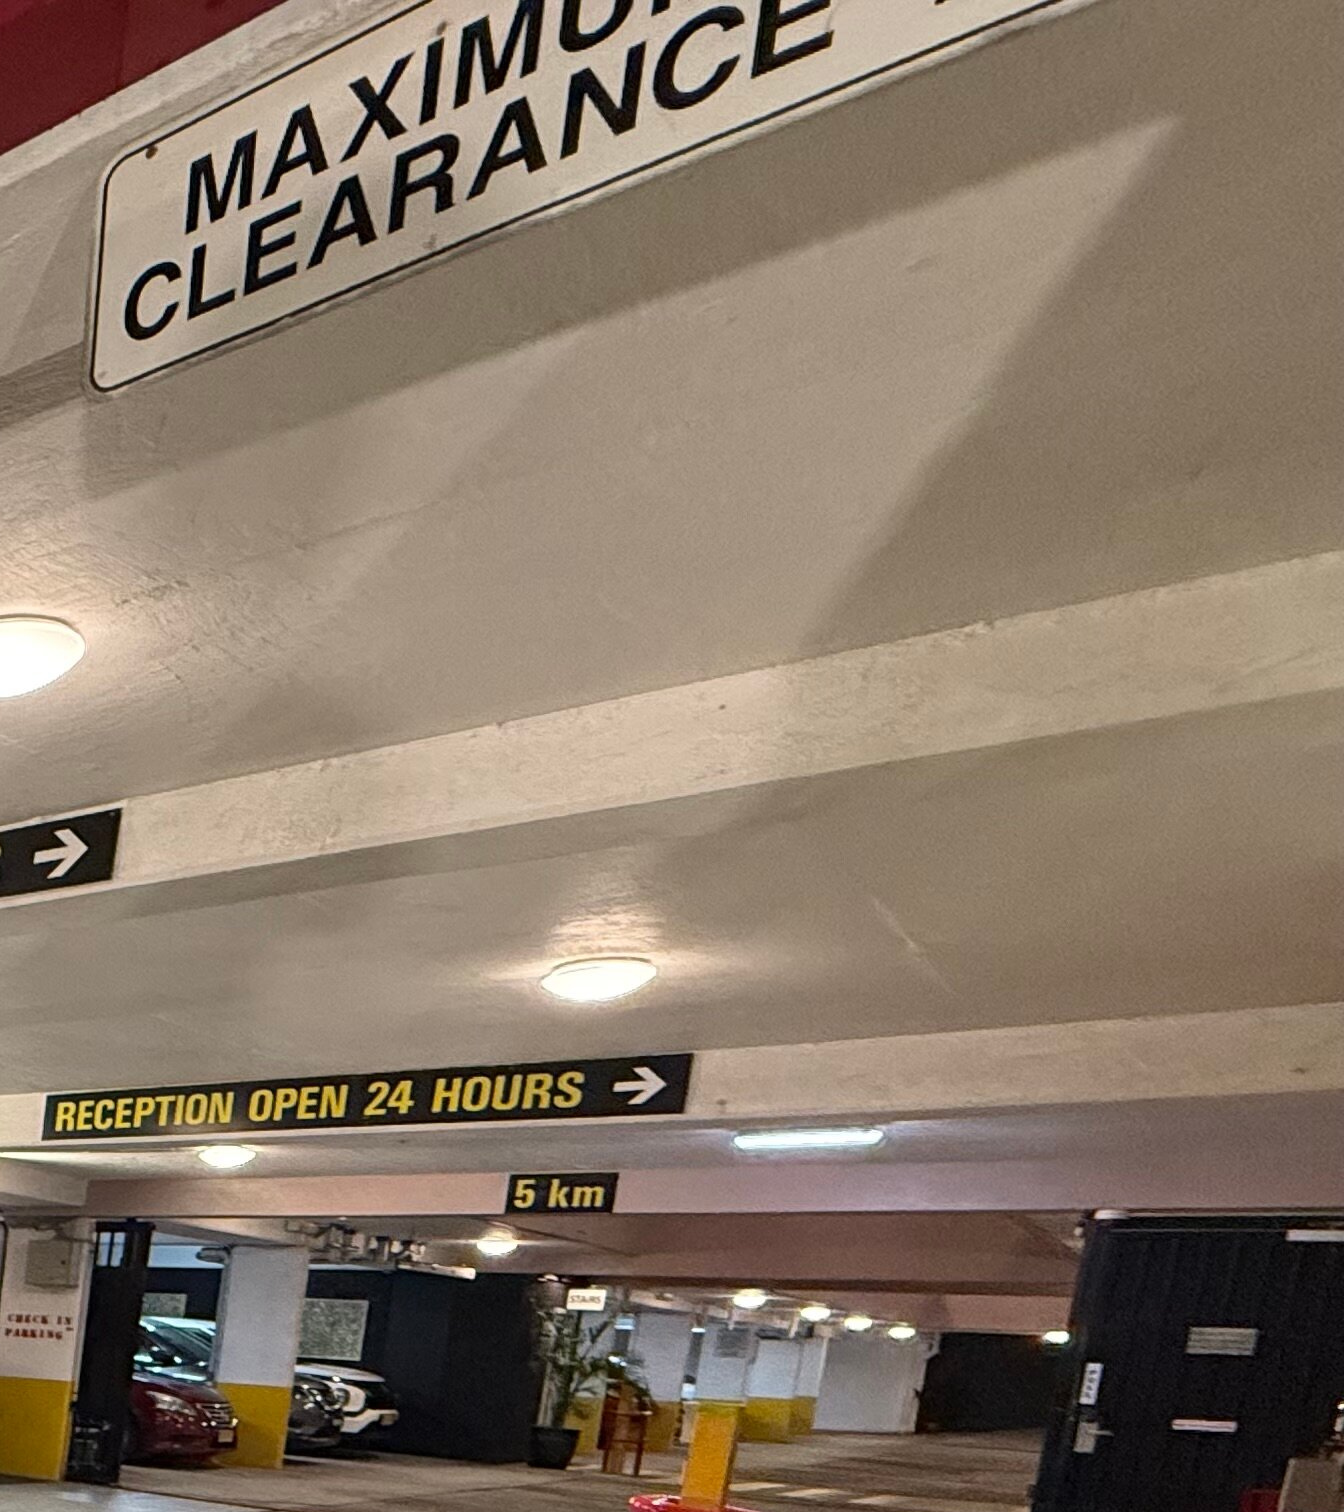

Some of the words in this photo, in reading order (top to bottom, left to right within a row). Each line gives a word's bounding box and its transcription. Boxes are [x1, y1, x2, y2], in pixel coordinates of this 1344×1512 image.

[184, 0, 670, 235] MAXIMU
[123, 0, 834, 341] CLEARANCE
[54, 1091, 235, 1133] RECEPTION
[248, 1084, 350, 1123] OPEN
[363, 1079, 415, 1117] 24
[431, 1071, 586, 1114] HOURS
[513, 1178, 537, 1209] 5
[547, 1178, 605, 1208] km
[4, 1327, 63, 1340] PARKING
[7, 1313, 48, 1325] CHECK
[57, 1315, 71, 1325] IN
